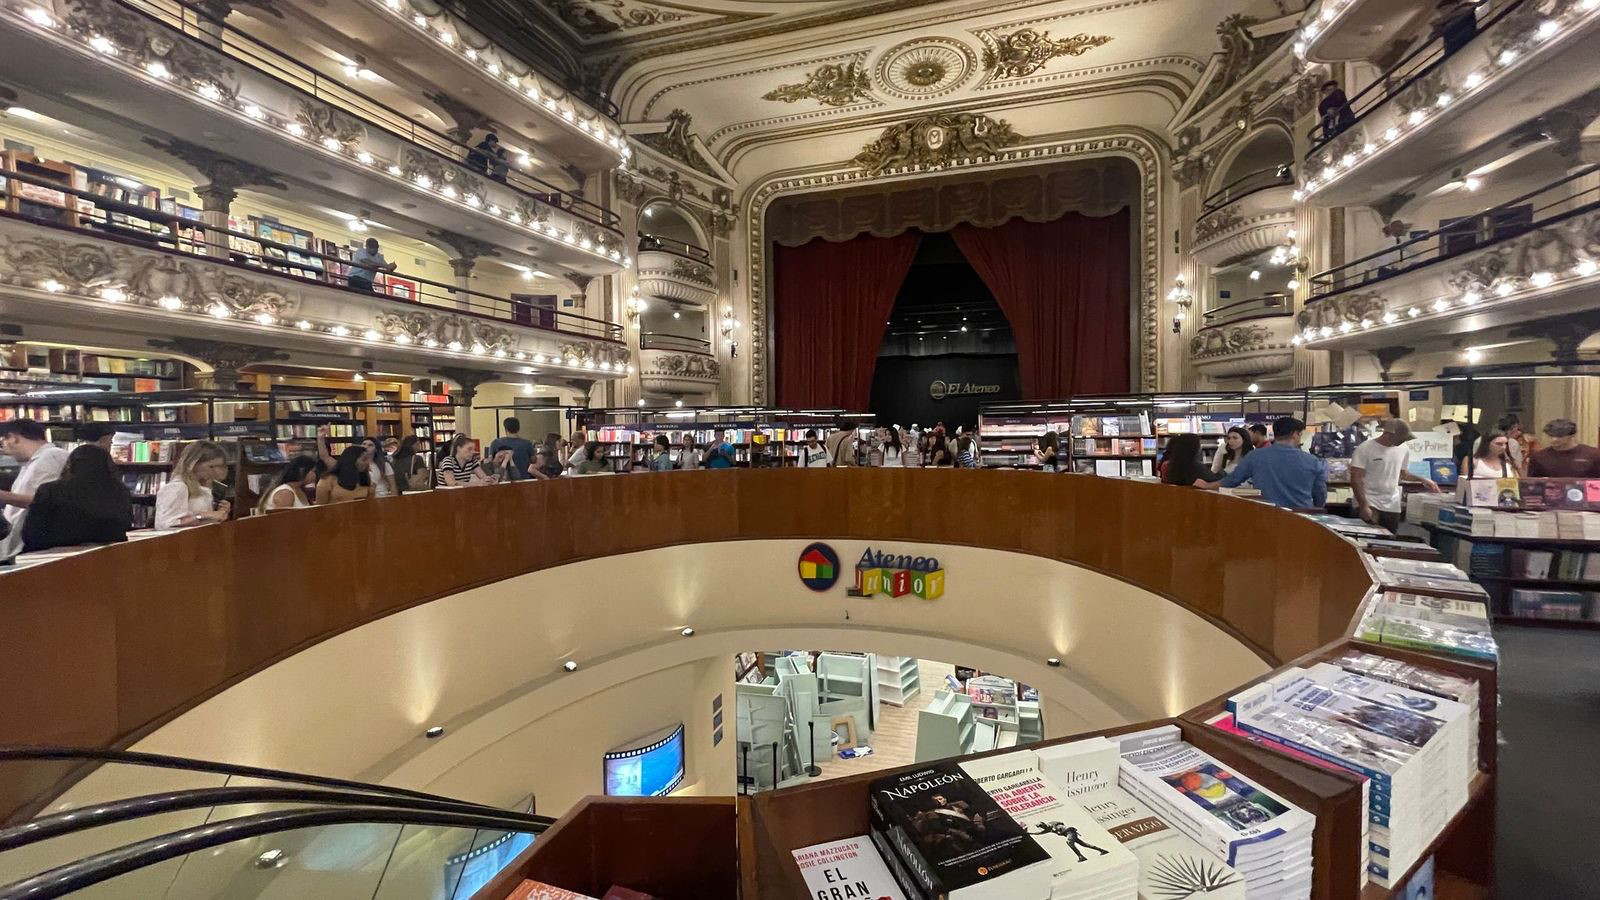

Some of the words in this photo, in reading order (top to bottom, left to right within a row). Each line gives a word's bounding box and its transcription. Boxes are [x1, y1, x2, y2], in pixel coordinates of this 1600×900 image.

[948, 383, 960, 395] El
[961, 382, 1000, 394] Ateneo
[857, 546, 939, 571] Ateneo
[912, 769, 935, 779] LUDWIG
[1067, 769, 1099, 783] Henry
[881, 772, 964, 800] NAPOLEÓN
[994, 792, 1012, 802] RTA
[1012, 783, 1045, 799] ABIERTA
[1000, 795, 1028, 808] SOBRE
[1028, 792, 1041, 800] LA
[1006, 795, 1056, 814] TOLERANCIA
[795, 850, 819, 861] ARIANA
[819, 843, 860, 856] MAZZUCATO
[800, 860, 816, 869] OSIE
[817, 851, 858, 865] COLLINGTON
[823, 867, 848, 883] EL
[817, 880, 870, 900] GRAN
